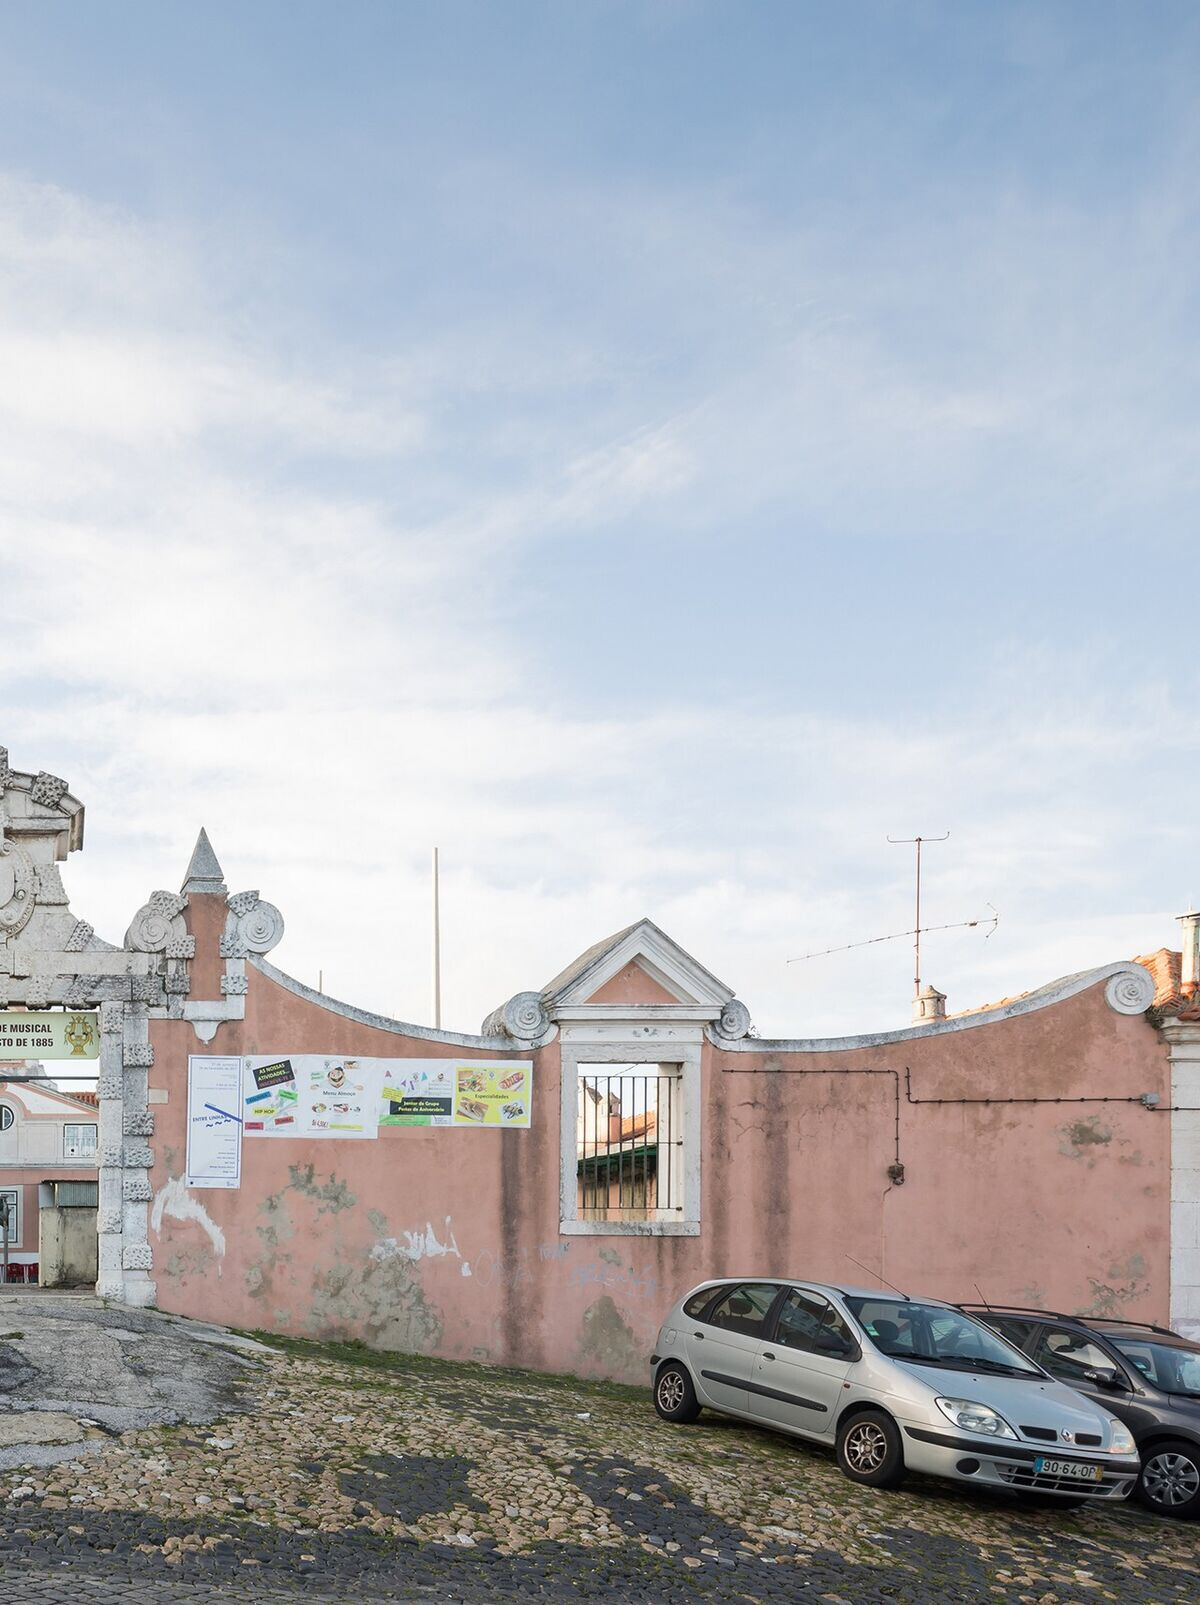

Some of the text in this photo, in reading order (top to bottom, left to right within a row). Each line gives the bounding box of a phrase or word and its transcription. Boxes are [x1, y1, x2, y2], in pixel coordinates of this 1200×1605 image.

[10, 1024, 52, 1033] MUSICAL
[16, 1038, 27, 1047] DE
[31, 1038, 54, 1047] 1885
[1043, 1461, 1096, 1478] 90-64-OP
